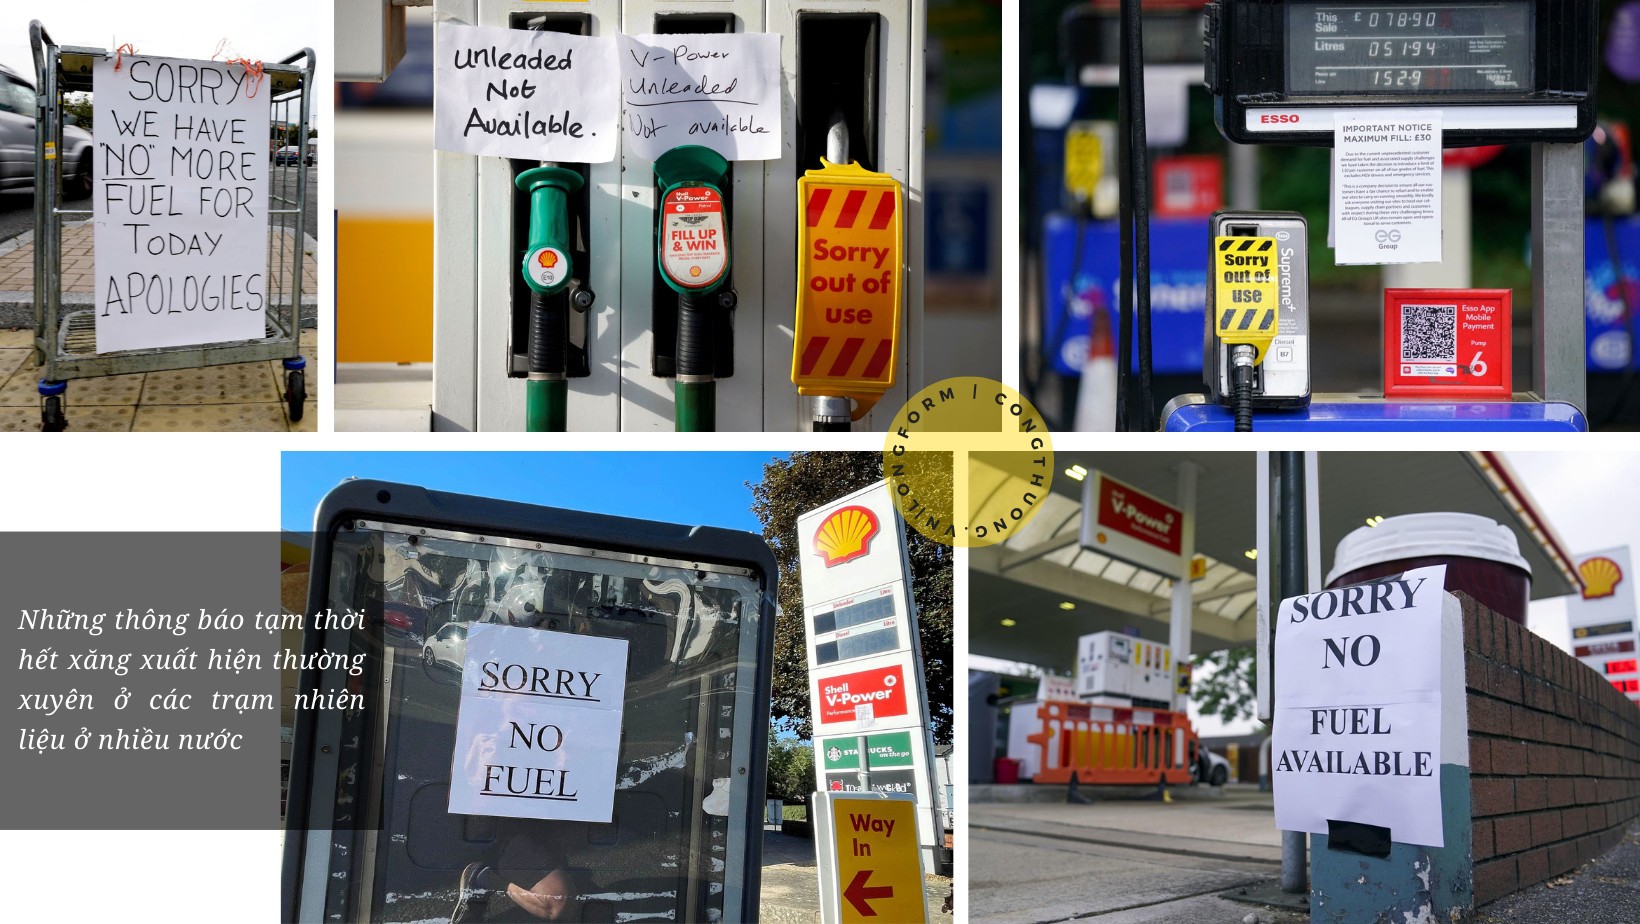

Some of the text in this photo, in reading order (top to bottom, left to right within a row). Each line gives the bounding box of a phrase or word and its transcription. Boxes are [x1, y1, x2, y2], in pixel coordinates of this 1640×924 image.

[1315, 12, 1337, 22] This
[1354, 12, 1362, 21] £
[1315, 23, 1338, 32] Sale
[1315, 42, 1345, 51] Litres
[454, 46, 573, 71] Unleaded
[129, 61, 247, 105] SORRY
[486, 79, 537, 101] Not
[629, 75, 738, 96] Unleaded
[111, 110, 246, 144] WE HAVE
[463, 107, 597, 138] Available.
[629, 114, 771, 138] Not available
[1260, 114, 1300, 123] ESSO
[1342, 123, 1432, 133] IMPORTANT NOTICE
[1343, 134, 1388, 143] MAXIMUM
[1391, 134, 1412, 142] FILL:
[171, 146, 256, 181] MORE
[105, 183, 254, 218] FUEL FOR
[672, 229, 717, 240] FILL UP
[672, 240, 717, 252] & WIN
[812, 238, 890, 269] Sorry
[1224, 254, 1269, 267] Sorry
[810, 270, 891, 294] out of
[1223, 269, 1271, 283] out of
[101, 272, 263, 316] APOLOGIES
[1232, 289, 1262, 303] use
[825, 306, 873, 324] use
[1480, 305, 1496, 313] App
[1462, 322, 1494, 331] Payment
[1470, 351, 1488, 377] 6
[833, 598, 854, 609] Unleaded
[1290, 578, 1428, 624] SORRY
[836, 630, 850, 638] Diesel
[1321, 634, 1381, 669] NO
[480, 661, 602, 698] SORRY
[824, 683, 848, 694] Shell
[826, 689, 892, 706] V-Power
[1309, 707, 1392, 735] FUEL
[509, 721, 563, 752] NO
[1275, 750, 1433, 777] AVAILABLE
[480, 764, 579, 798] FUEL
[849, 813, 895, 838] Way
[852, 838, 871, 857] In
